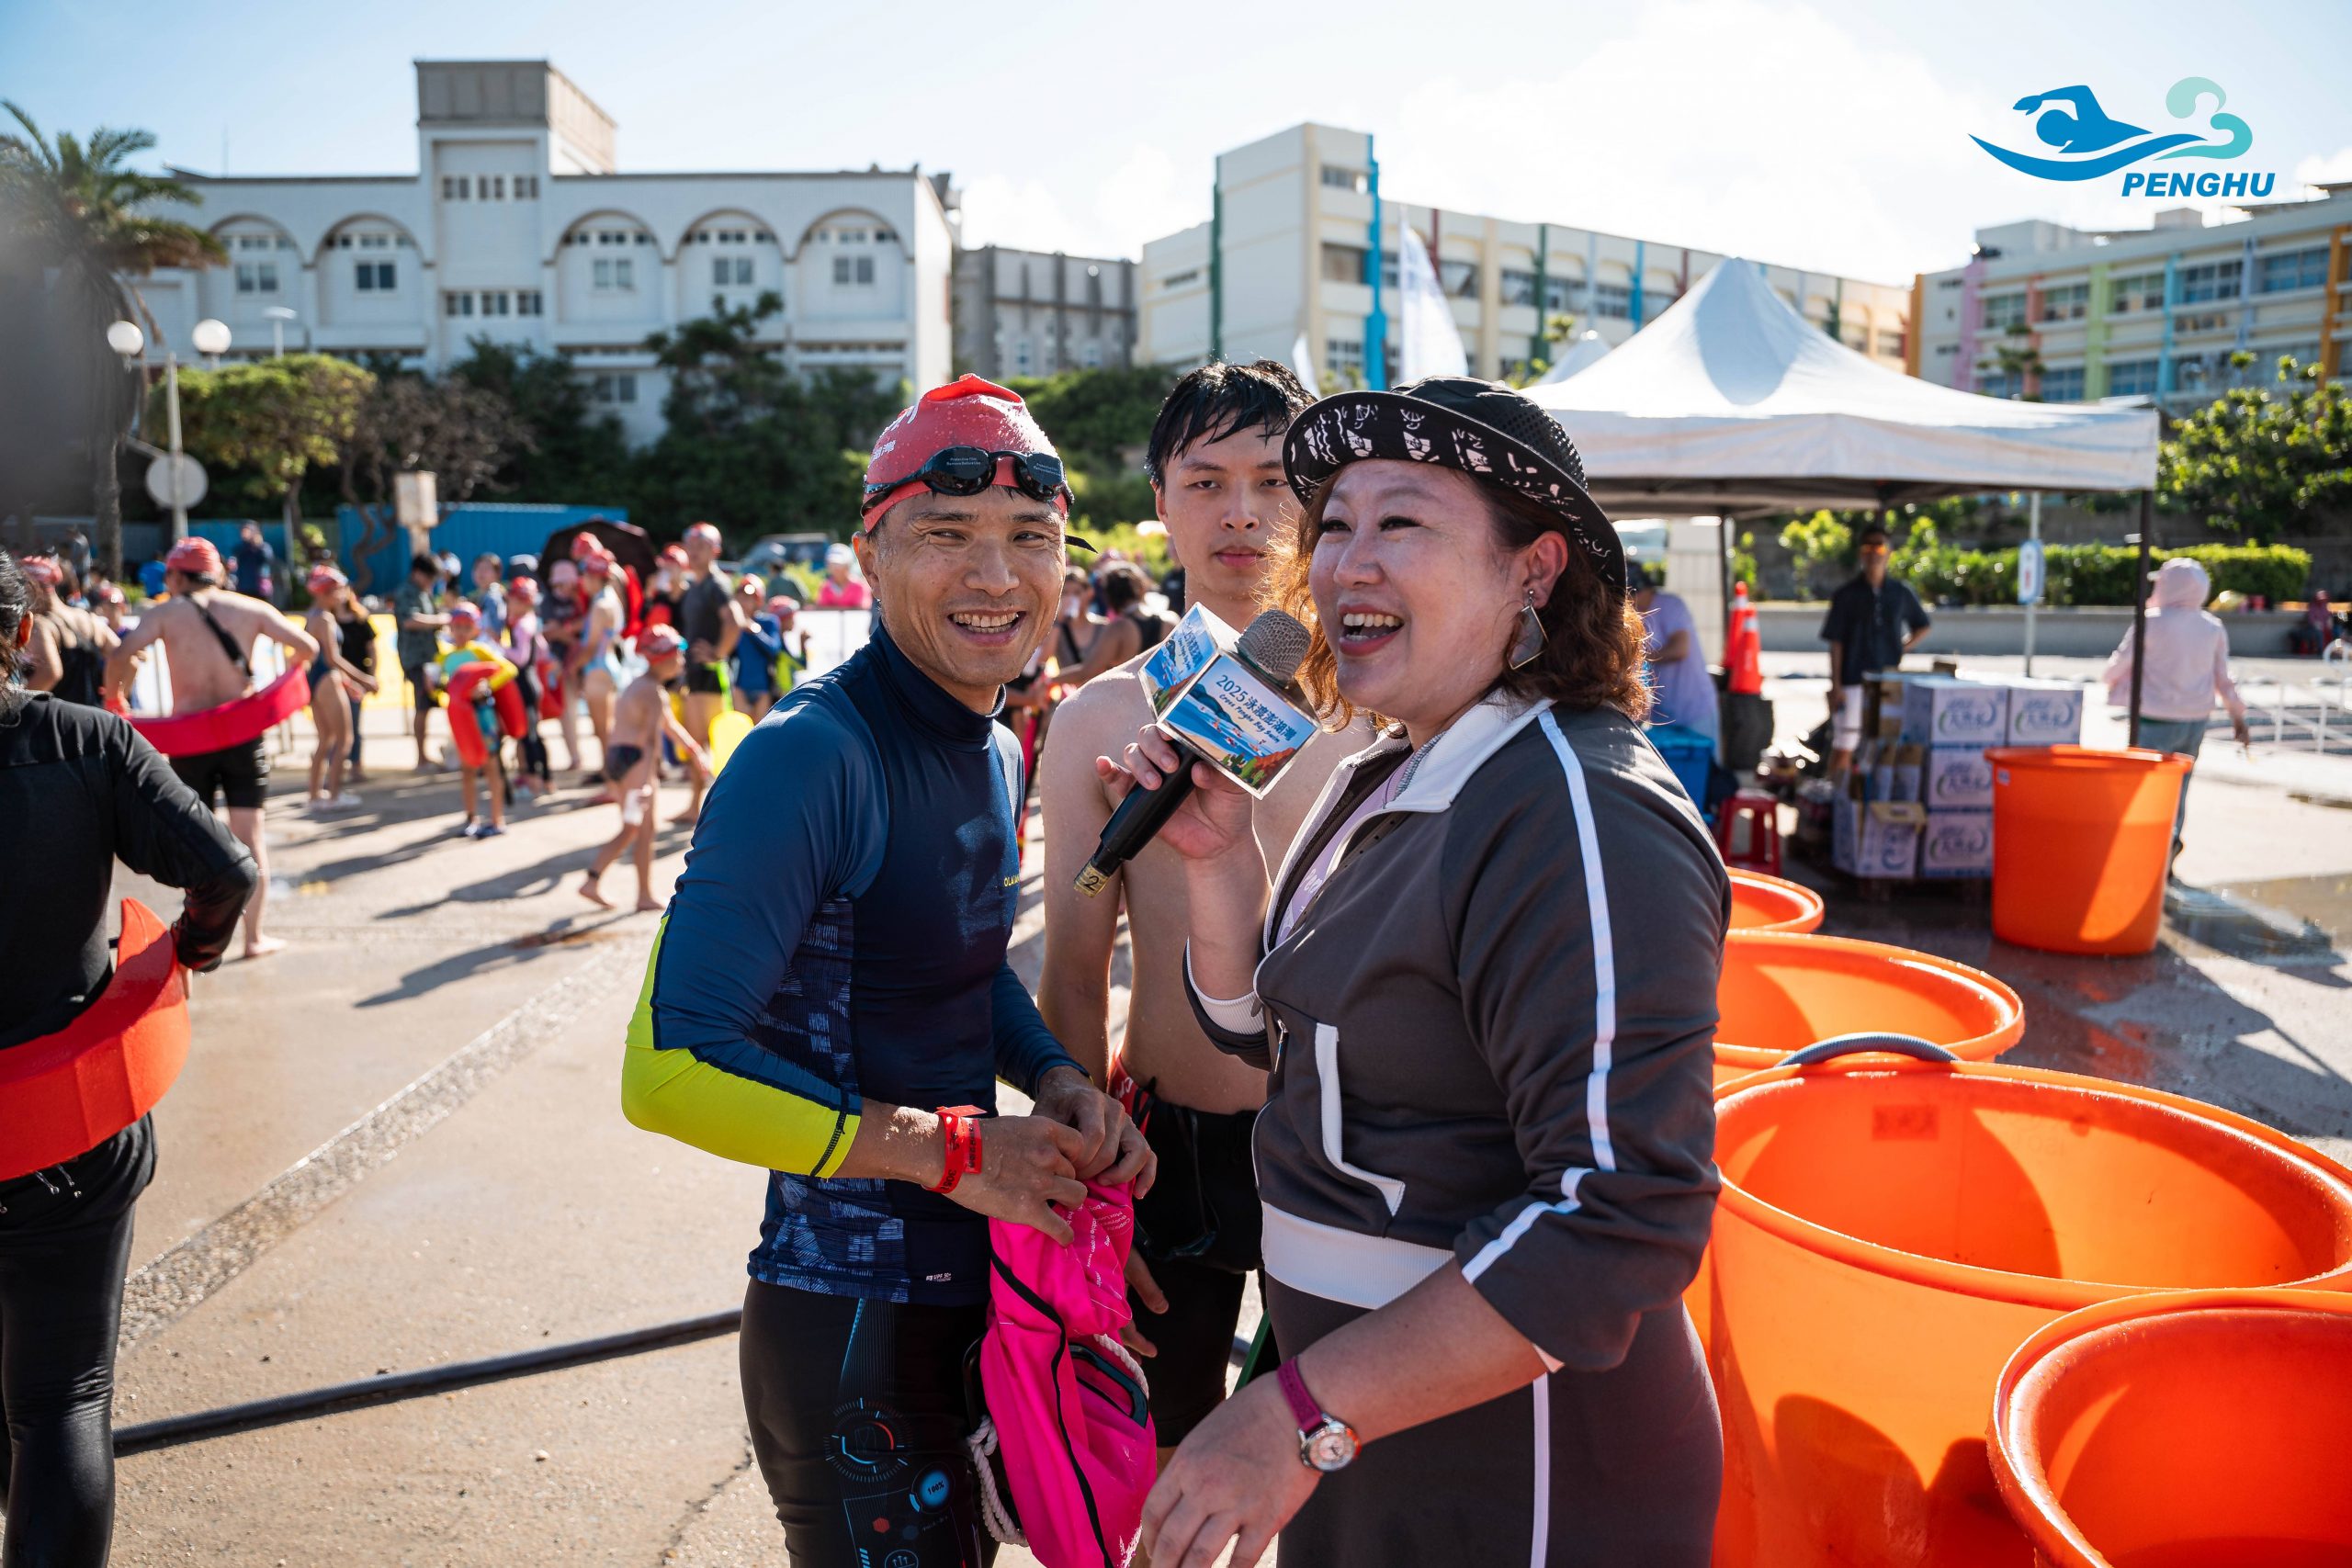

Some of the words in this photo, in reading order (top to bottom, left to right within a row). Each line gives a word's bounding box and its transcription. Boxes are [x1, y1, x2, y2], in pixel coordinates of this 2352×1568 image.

[1219, 694, 1236, 707] Cross
[1235, 705, 1254, 723] Penghu
[1253, 720, 1266, 733] Bay
[1264, 729, 1280, 743] Swim
[1084, 875, 1099, 891] 2
[927, 1481, 944, 1495] 100%
